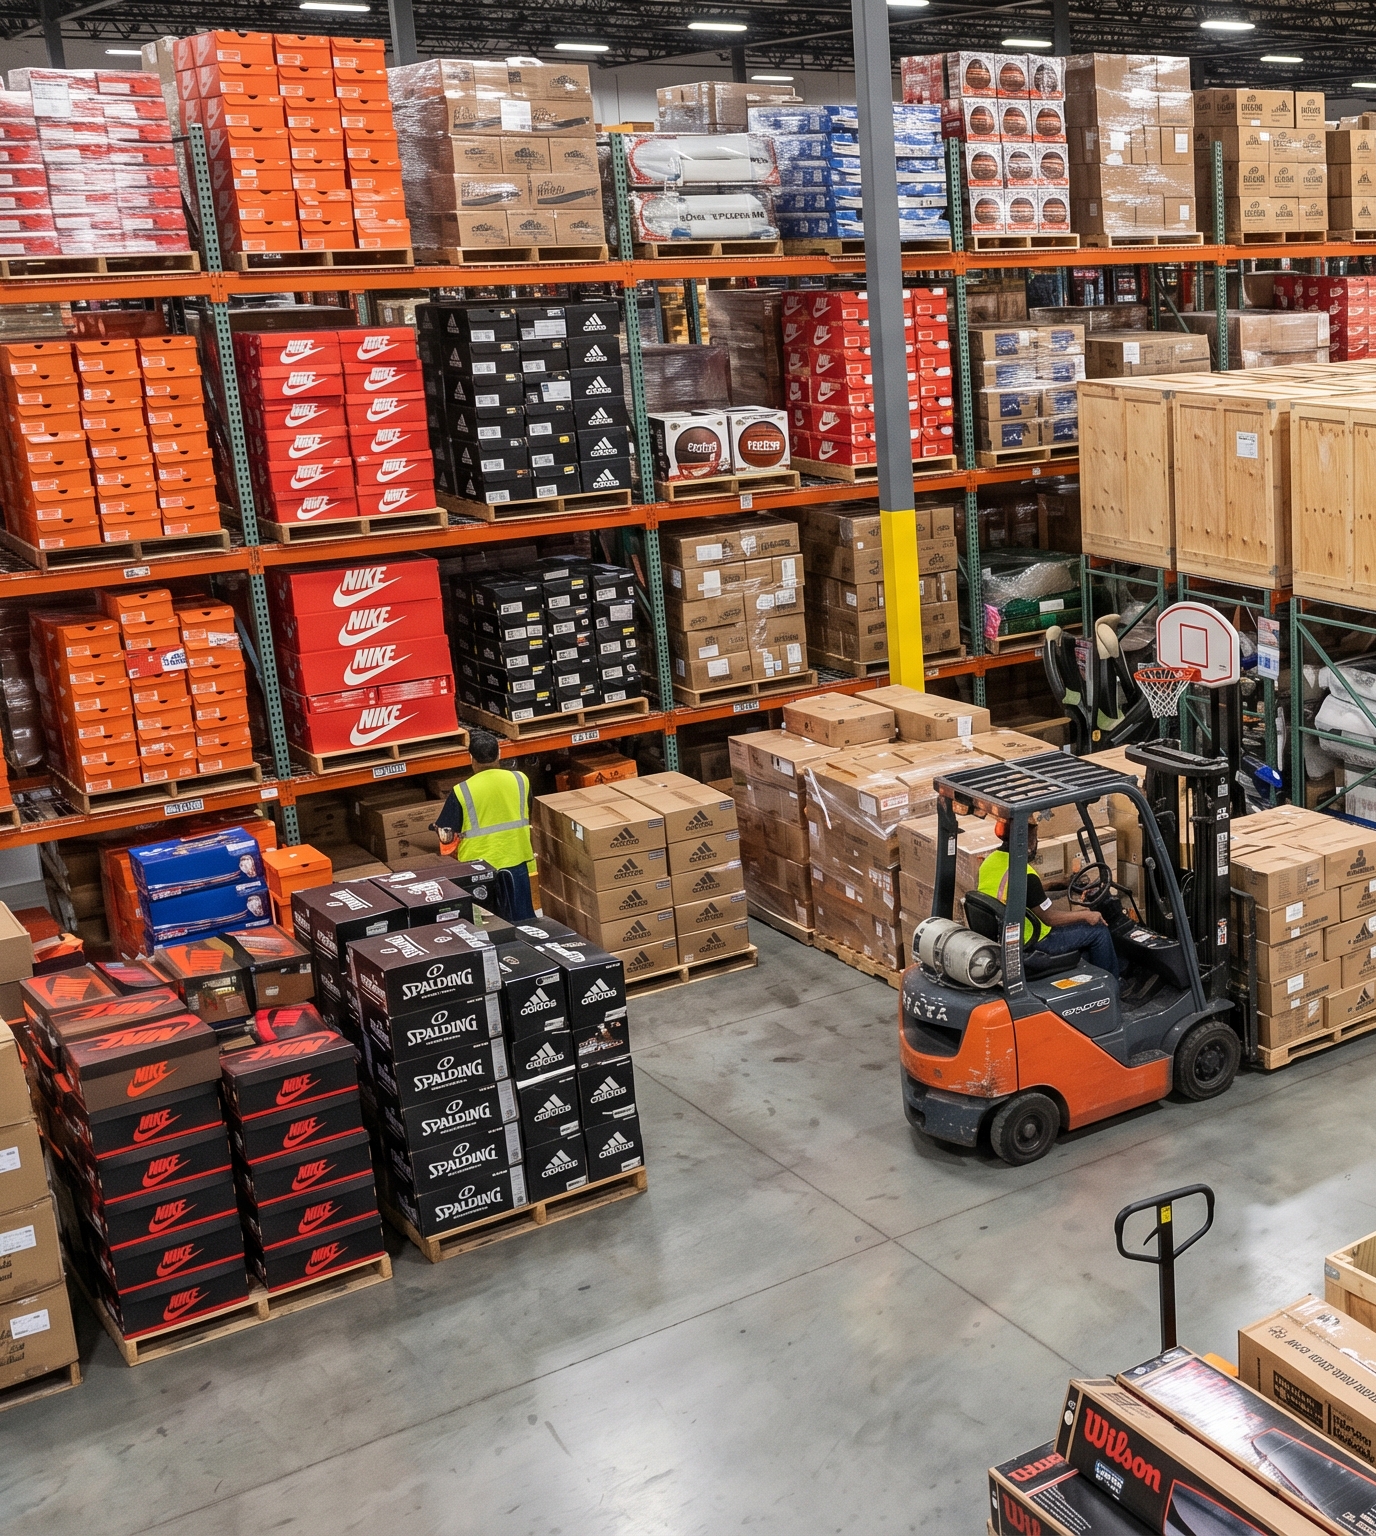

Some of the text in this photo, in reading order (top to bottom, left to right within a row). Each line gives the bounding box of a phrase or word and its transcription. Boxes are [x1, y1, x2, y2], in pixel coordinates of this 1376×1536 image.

[342, 566, 387, 591] NIKE
[347, 606, 391, 631] NIKE
[352, 645, 396, 670] NIKE
[358, 704, 402, 730] NIKE
[402, 968, 474, 1000] SPALDING
[407, 1015, 478, 1046] SPALDING
[414, 1059, 485, 1092] SPALDING
[421, 1102, 492, 1136] SPALDING
[429, 1144, 498, 1179] SPALDING
[435, 1187, 503, 1222] SPALDING
[1084, 1408, 1161, 1493] Wilson
